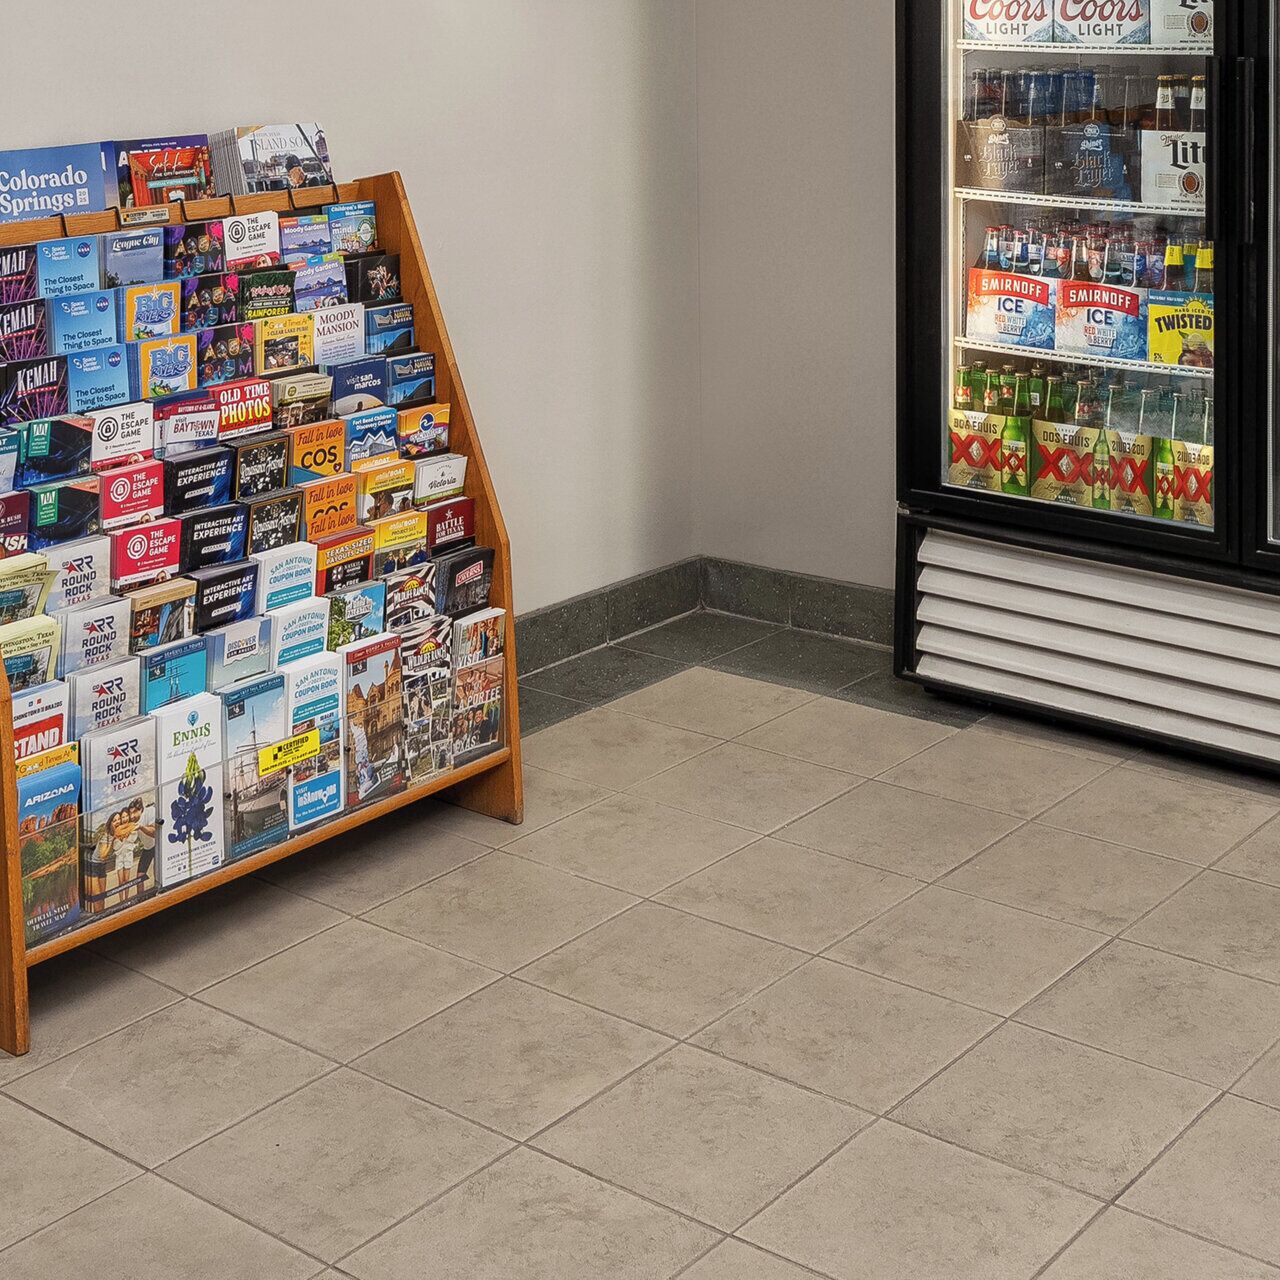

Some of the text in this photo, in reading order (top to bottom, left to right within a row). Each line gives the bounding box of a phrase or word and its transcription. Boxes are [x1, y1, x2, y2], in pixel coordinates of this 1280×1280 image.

[986, 23, 1029, 35] LIGHT
[1078, 24, 1123, 36] LIGHT
[0, 192, 74, 216] Springs
[284, 223, 327, 235] Moody Gardens
[982, 278, 1042, 297] SMIRNOFF
[136, 292, 175, 312] BIG
[998, 298, 1023, 314] ICE
[1070, 289, 1132, 308] SMIRNOFF
[248, 307, 289, 318] RAINFOREST
[320, 309, 355, 325] MOODY
[1086, 309, 1113, 325] ICE
[316, 320, 359, 337] MANSION
[1084, 326, 1116, 338] RED WHITE
[1155, 316, 1212, 333] TWISTED
[63, 329, 102, 341] The Closest
[1093, 336, 1112, 346] BERRY
[150, 346, 191, 367] BIG
[17, 361, 57, 388] KEMAH
[346, 375, 360, 385] visit
[76, 385, 115, 397] The Closest
[220, 382, 269, 401] OLD TIME
[354, 379, 381, 390] marcos
[76, 397, 93, 406] Thing
[104, 391, 125, 401] Space
[221, 399, 270, 425] PHOTOS
[972, 420, 998, 434] EQUIS
[1042, 431, 1090, 448] DOS EQUIS
[301, 445, 337, 468] COS
[133, 472, 146, 481] THE
[177, 467, 228, 486] EXPERIENCE
[428, 477, 456, 490] Victoria
[133, 478, 158, 491] ESCAPE
[133, 488, 152, 498] GAME
[436, 517, 464, 530] BATTLE
[150, 529, 164, 538] THE
[436, 526, 464, 538] FOR TEXAS
[150, 535, 176, 547] ESCAPE
[150, 545, 169, 555] GAME
[204, 574, 253, 595] INTERACTIVE ART
[203, 582, 253, 604] EXPERIENCE
[282, 623, 324, 640] COUPON BOOK
[228, 635, 257, 649] DISCOVER
[87, 654, 110, 665] TEXAS
[295, 669, 338, 688] SAN ANTONIO
[295, 685, 319, 698] COUPON
[320, 679, 337, 690] BOOK
[92, 692, 126, 711] ROUND
[95, 706, 122, 721] ROCK
[173, 722, 211, 746] ENNIS
[283, 736, 309, 750] CERTIFIED
[107, 755, 142, 774] ROUND
[110, 768, 138, 784] ROCK
[113, 778, 136, 791] TEXAS
[24, 783, 74, 807] ARIZONA
